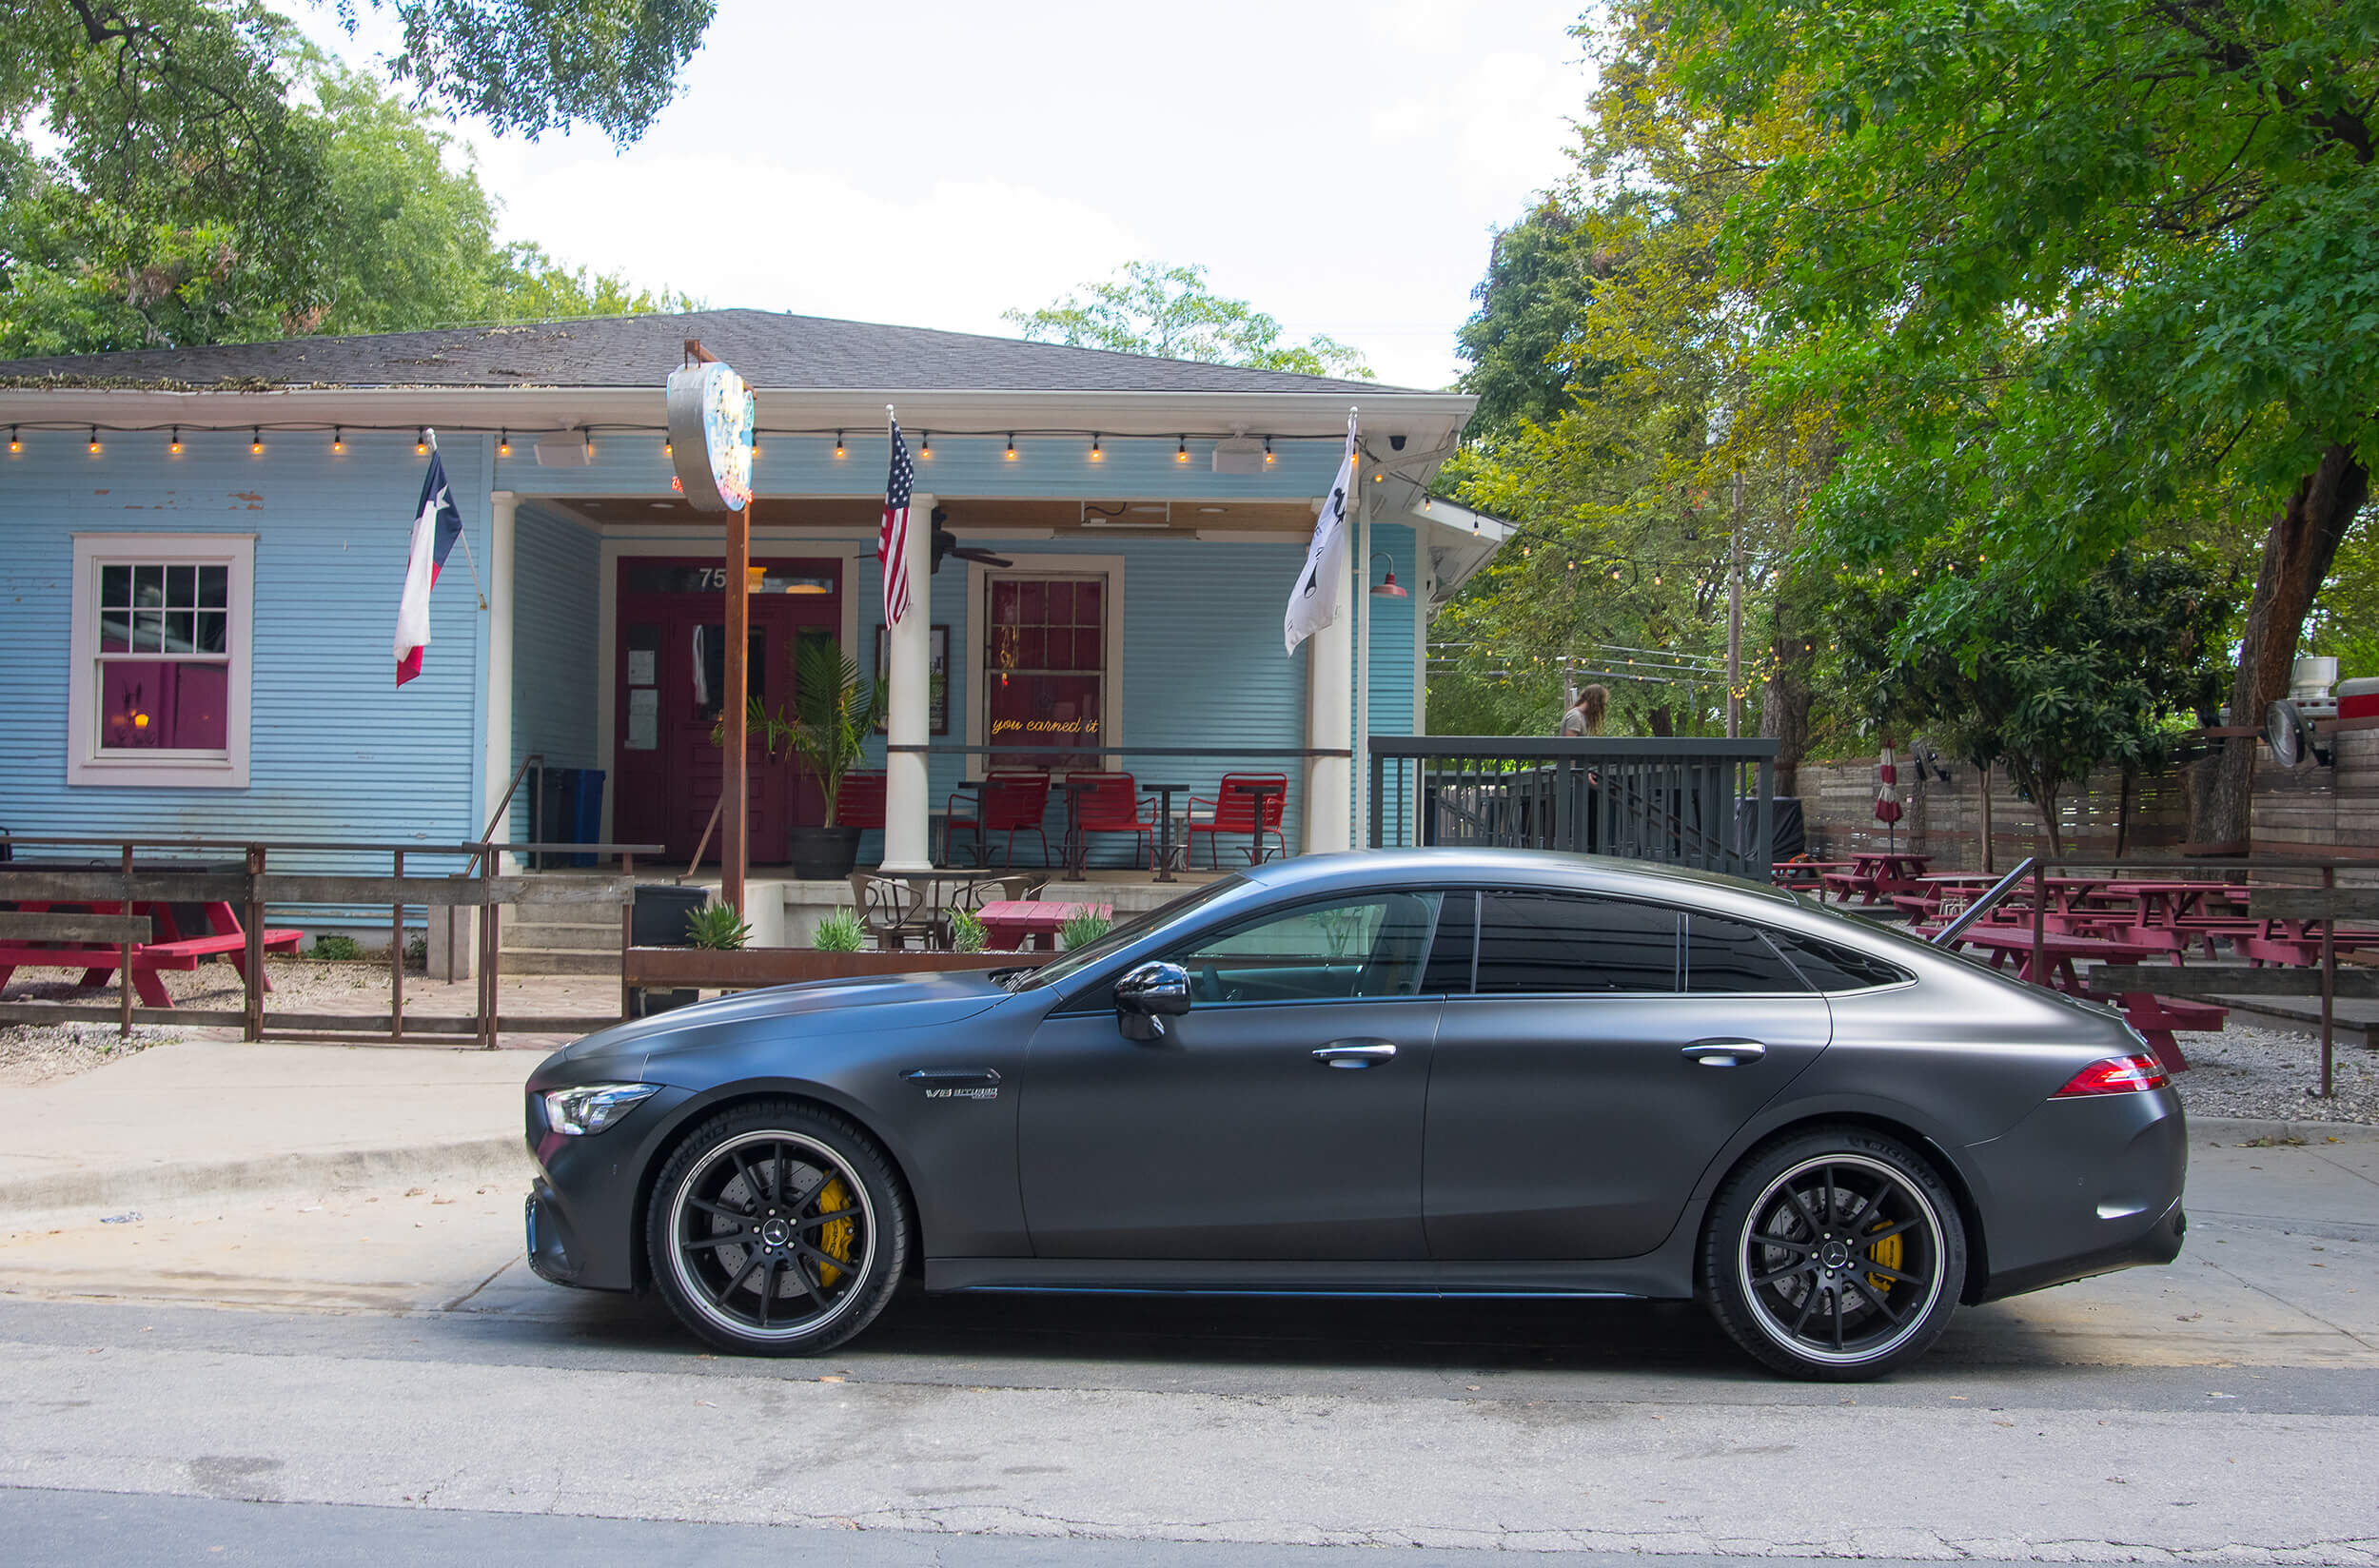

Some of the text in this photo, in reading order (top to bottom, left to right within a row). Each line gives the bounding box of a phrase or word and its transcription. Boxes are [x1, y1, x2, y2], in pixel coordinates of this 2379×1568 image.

[991, 715, 1099, 735] you earned it
